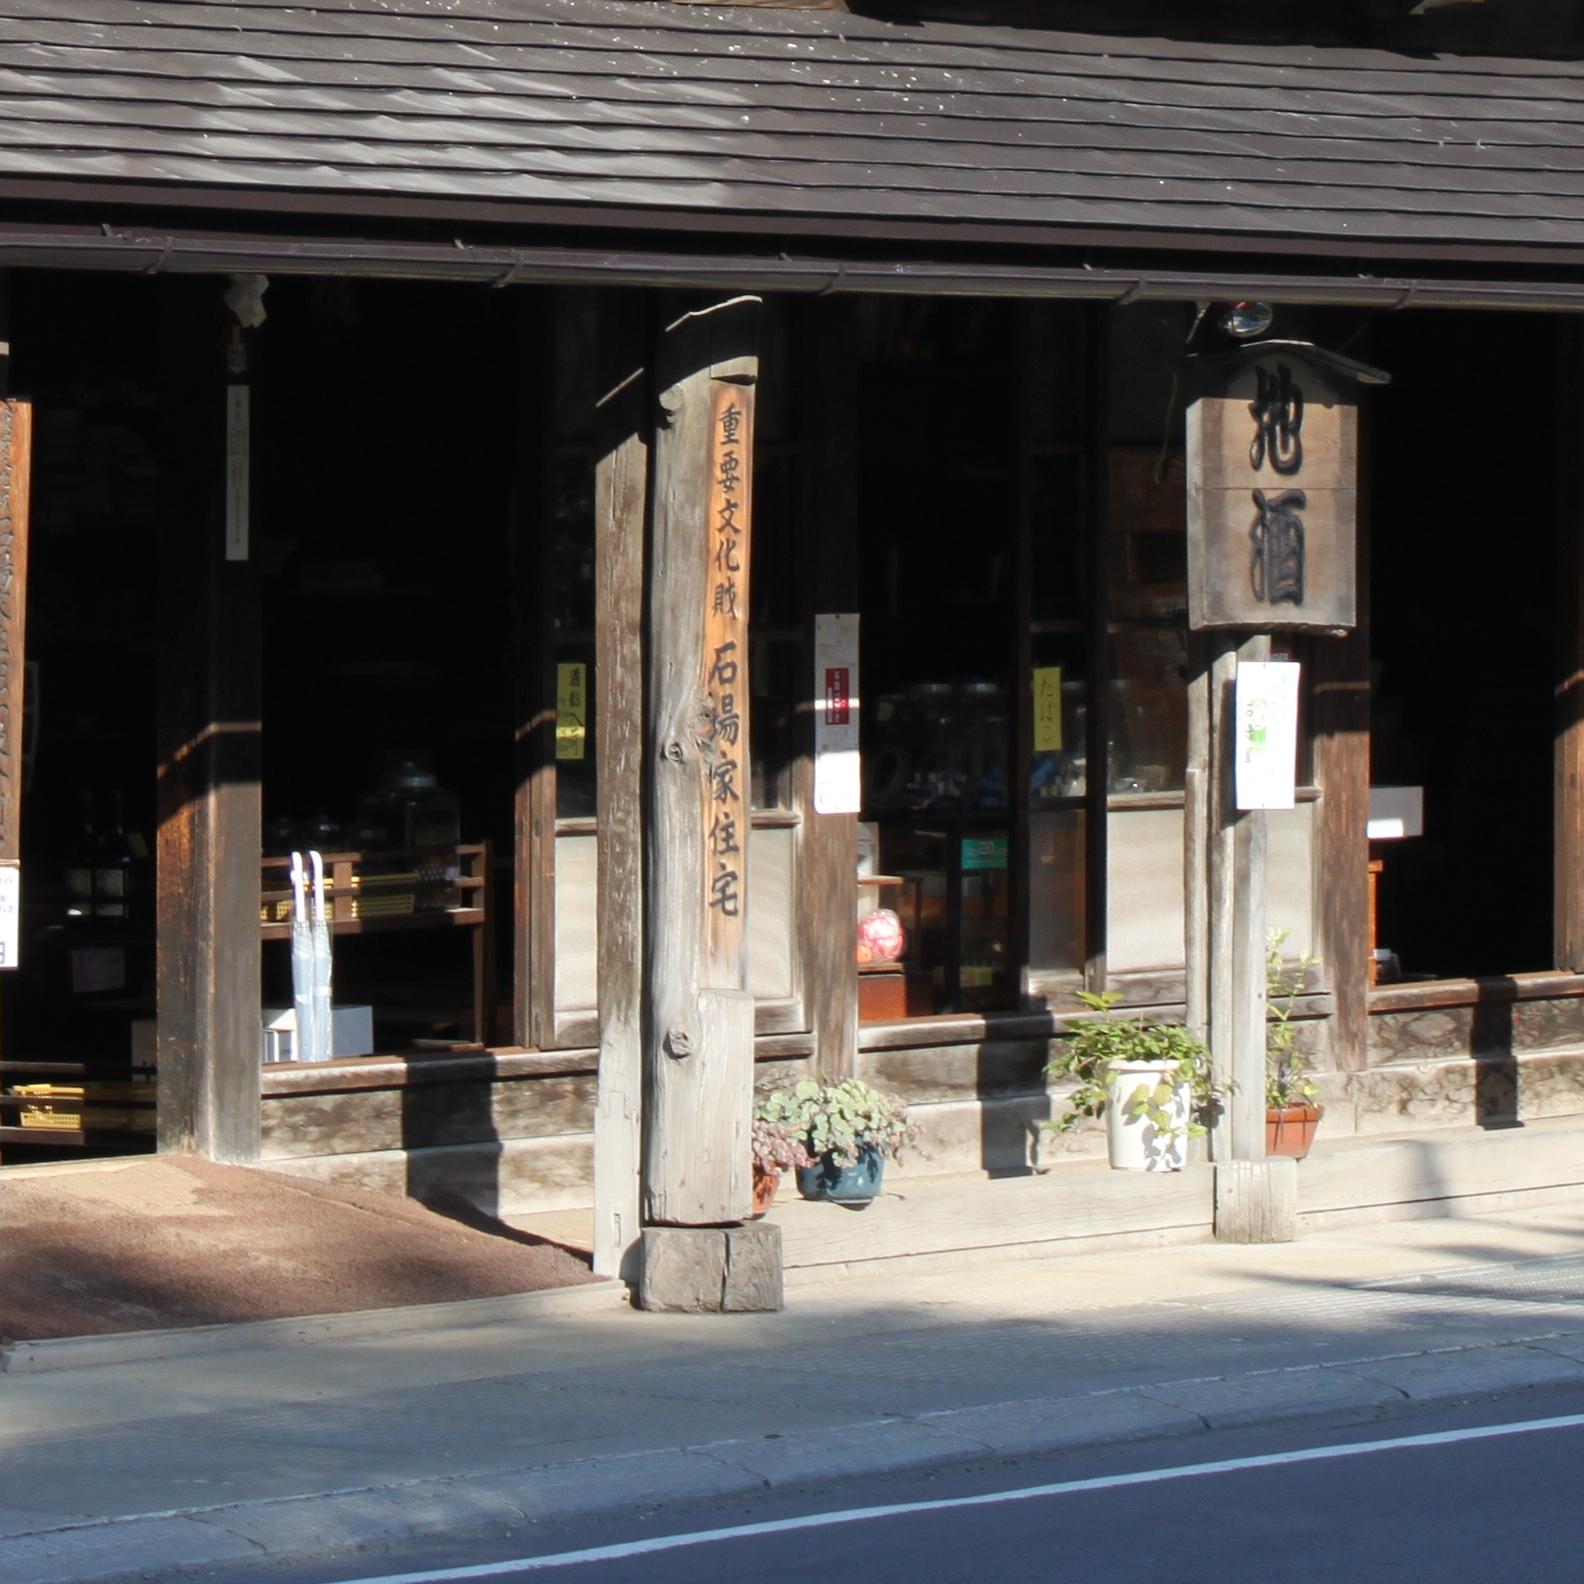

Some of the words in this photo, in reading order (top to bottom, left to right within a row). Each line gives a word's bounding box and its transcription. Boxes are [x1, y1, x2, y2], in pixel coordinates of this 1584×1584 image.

[713, 402, 742, 620] 重要文化財
[1248, 364, 1306, 605] 地酒
[708, 640, 740, 916] 石場家住宅
